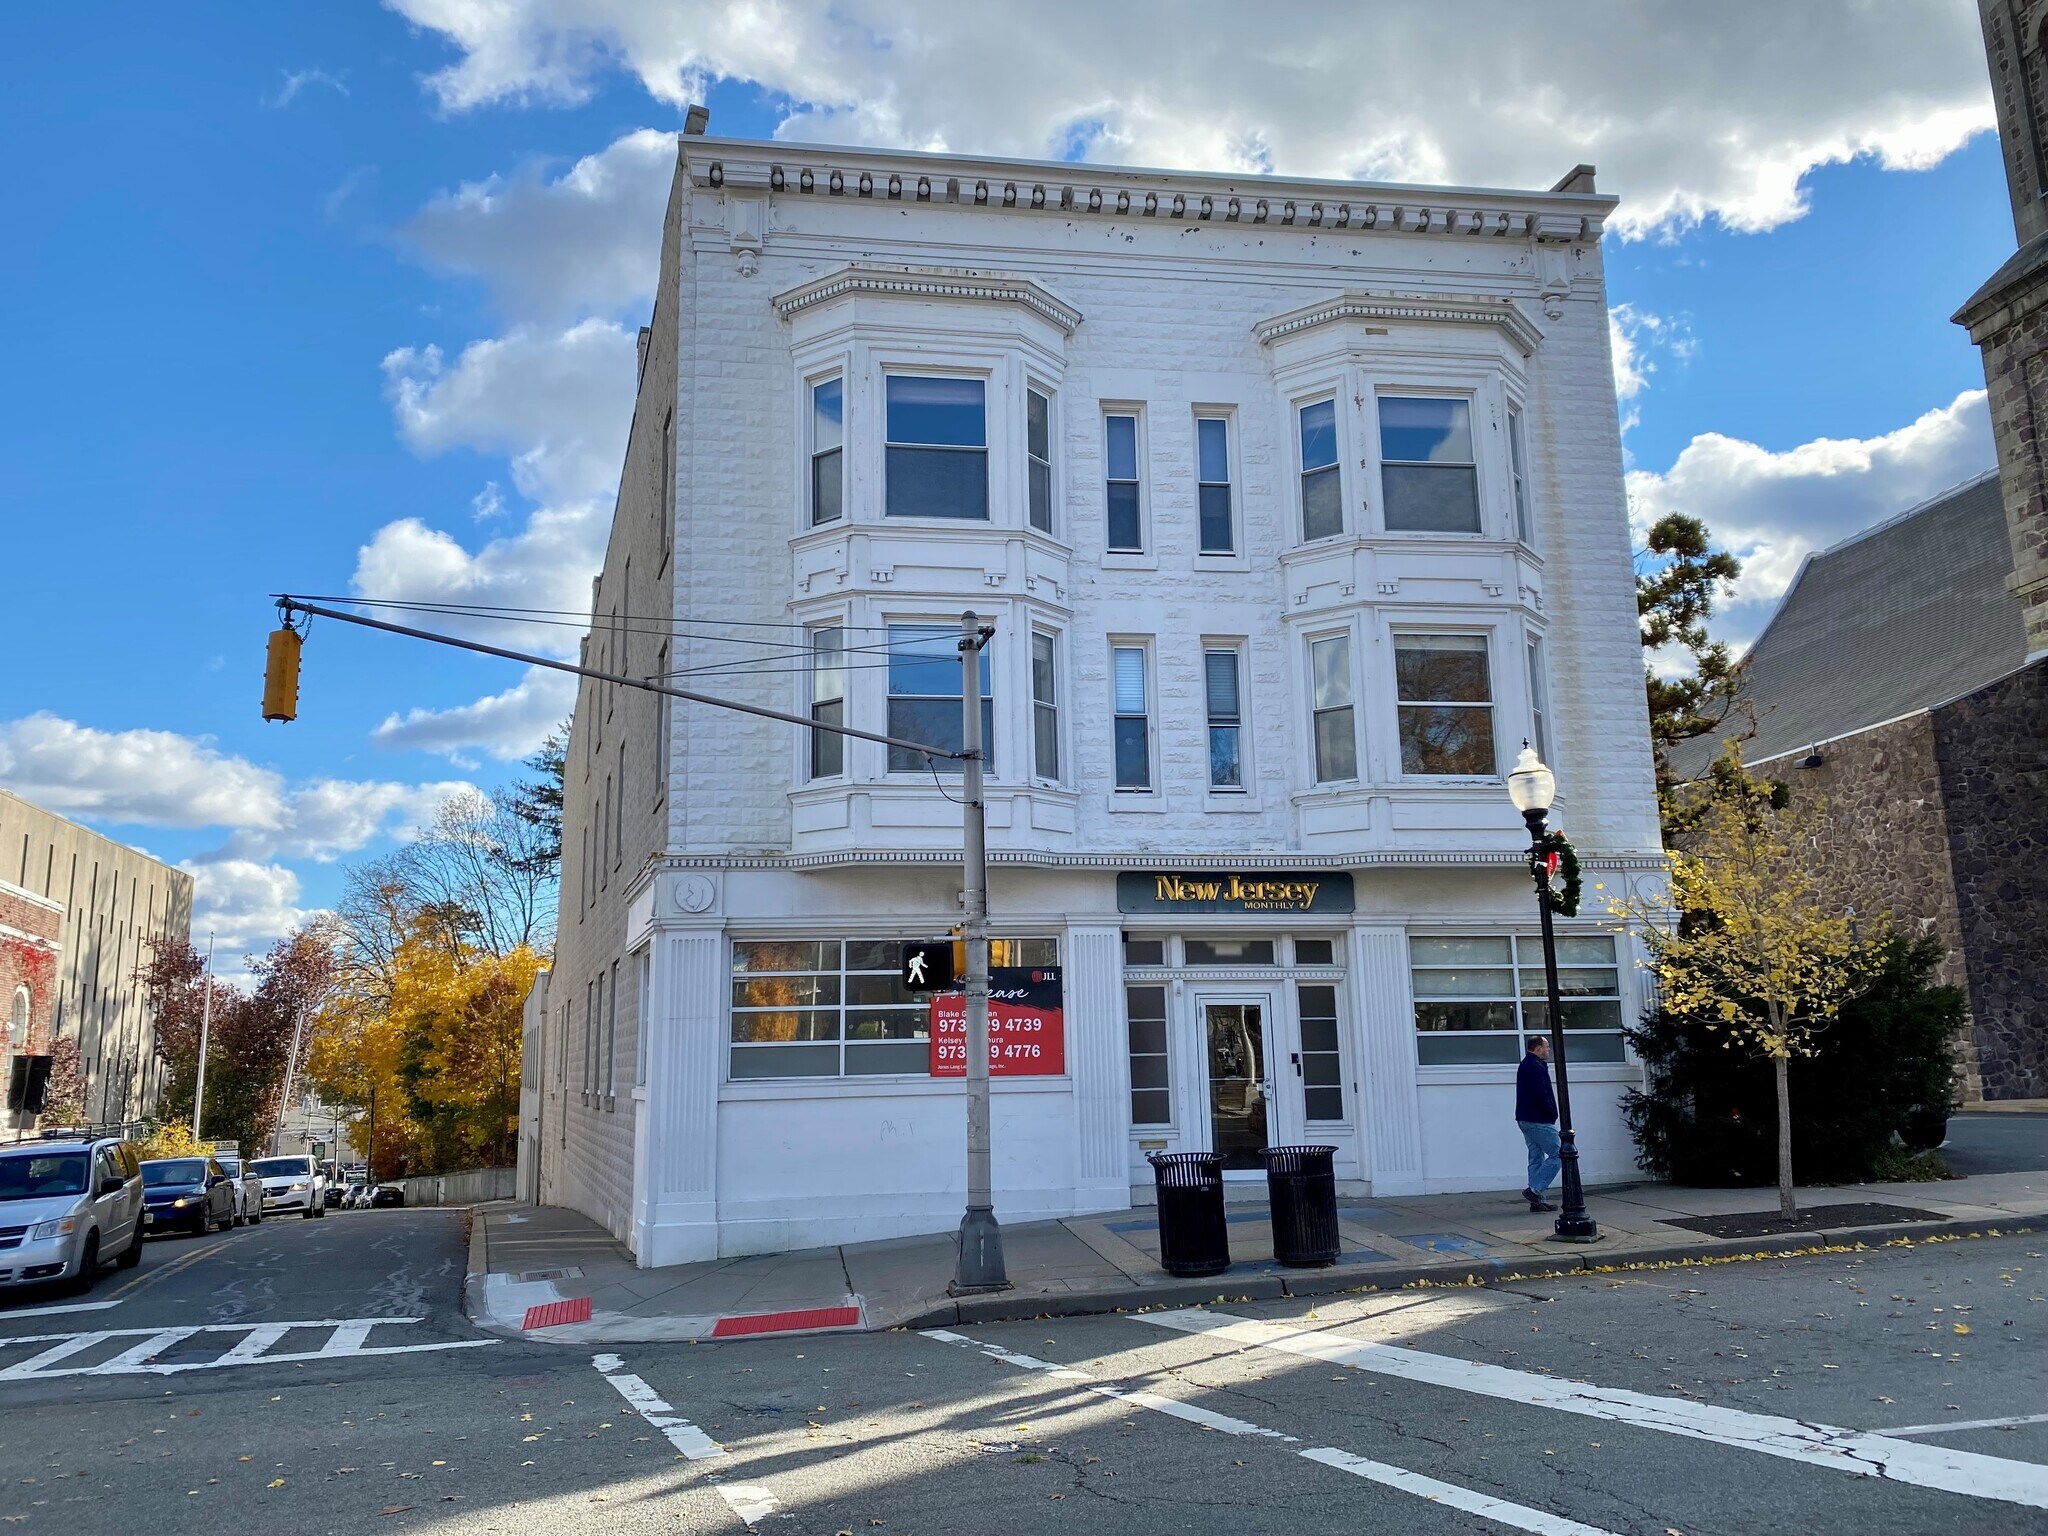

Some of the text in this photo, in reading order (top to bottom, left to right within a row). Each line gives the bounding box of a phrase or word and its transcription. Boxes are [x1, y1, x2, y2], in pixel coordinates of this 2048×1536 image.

[1154, 875, 1319, 910] New Jersey
[1244, 902, 1295, 910] MONTHLY
[1042, 972, 1057, 981] JLL
[986, 988, 1029, 999] ease
[938, 1010, 960, 1018] Blake
[939, 1019, 967, 1033] 973
[1005, 1018, 1042, 1032] 4739
[938, 1037, 963, 1045] Kelsey
[938, 1045, 966, 1059] 973
[1004, 1044, 1041, 1058] 4776
